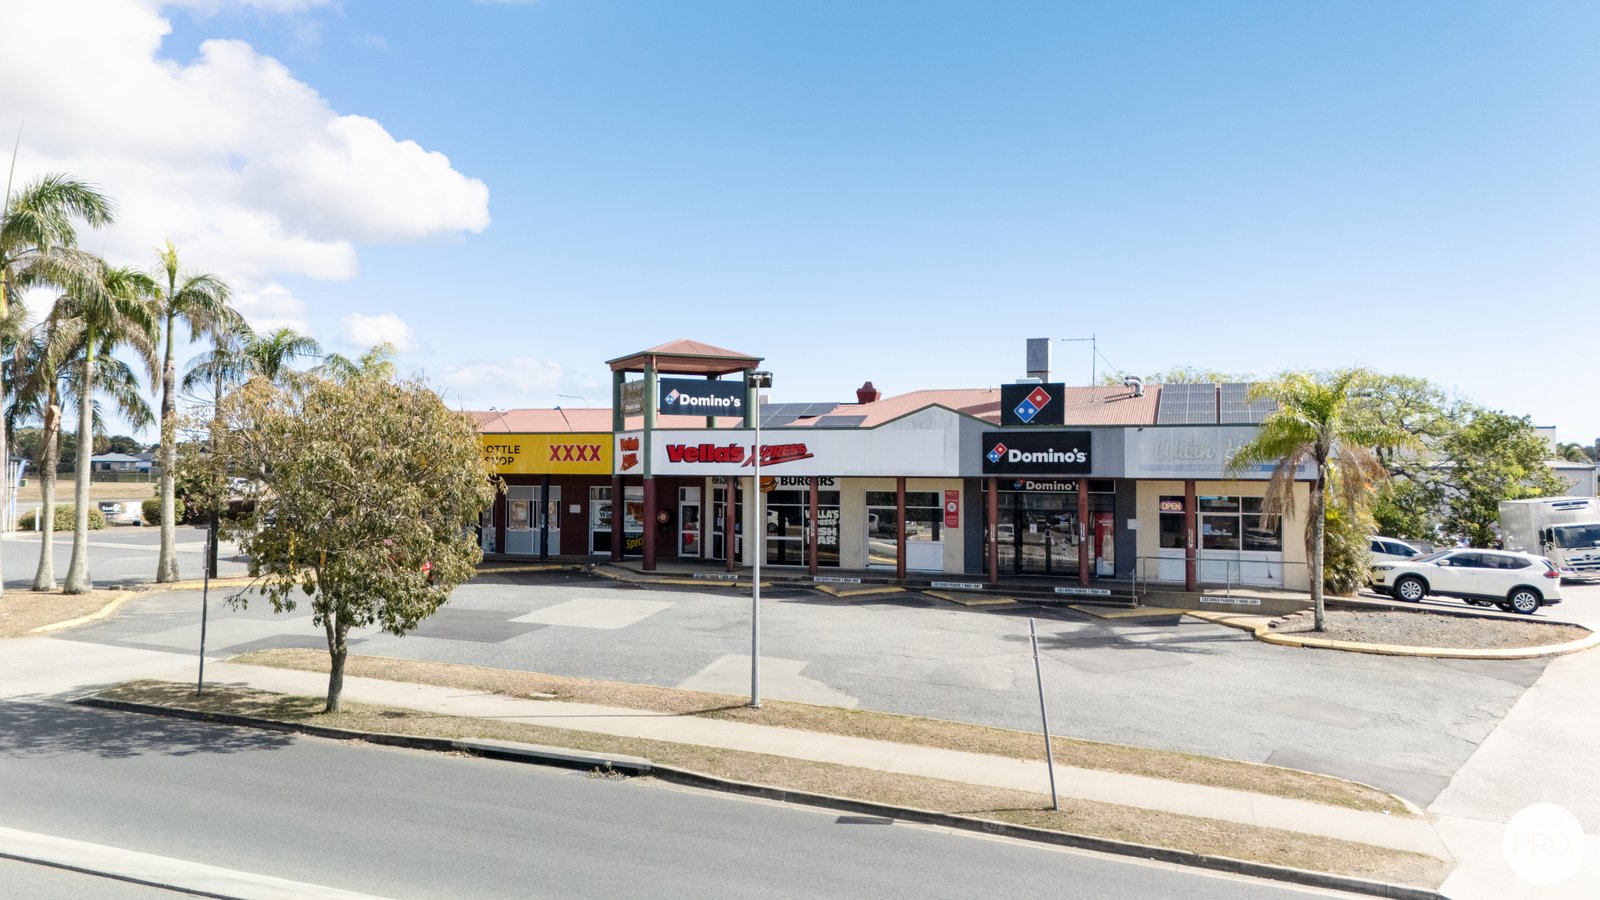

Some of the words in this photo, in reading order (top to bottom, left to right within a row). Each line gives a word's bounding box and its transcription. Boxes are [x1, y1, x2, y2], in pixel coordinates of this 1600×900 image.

[680, 394, 741, 407] Domino's
[549, 444, 601, 462] XXXX
[666, 443, 744, 463] Vella's
[1008, 448, 1087, 463] Domino's
[781, 477, 834, 486] BURGRS
[805, 510, 839, 519] VLLA'S
